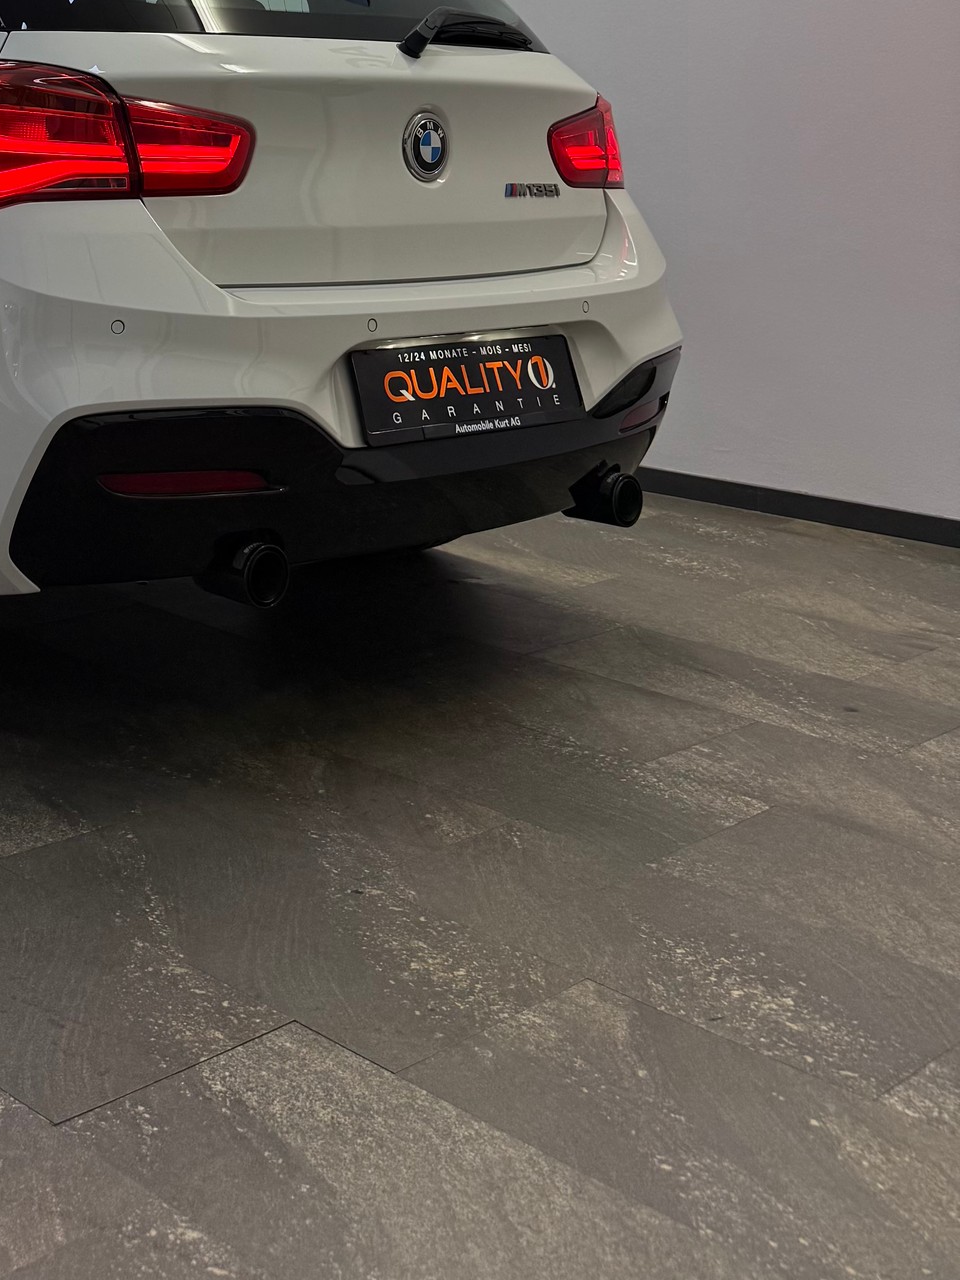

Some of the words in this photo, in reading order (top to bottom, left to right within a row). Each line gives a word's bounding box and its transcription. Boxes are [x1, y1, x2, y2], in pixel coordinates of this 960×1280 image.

[414, 121, 445, 138] BMW
[398, 351, 426, 363] 12/24
[429, 348, 469, 360] MONATE
[480, 345, 502, 355] MOIS
[511, 343, 532, 353] MESI
[384, 359, 522, 403] QUALITY
[392, 394, 561, 424] GARANTIE
[455, 419, 494, 434] Automobile
[494, 419, 510, 429] Kurt
[511, 416, 521, 426] AG
